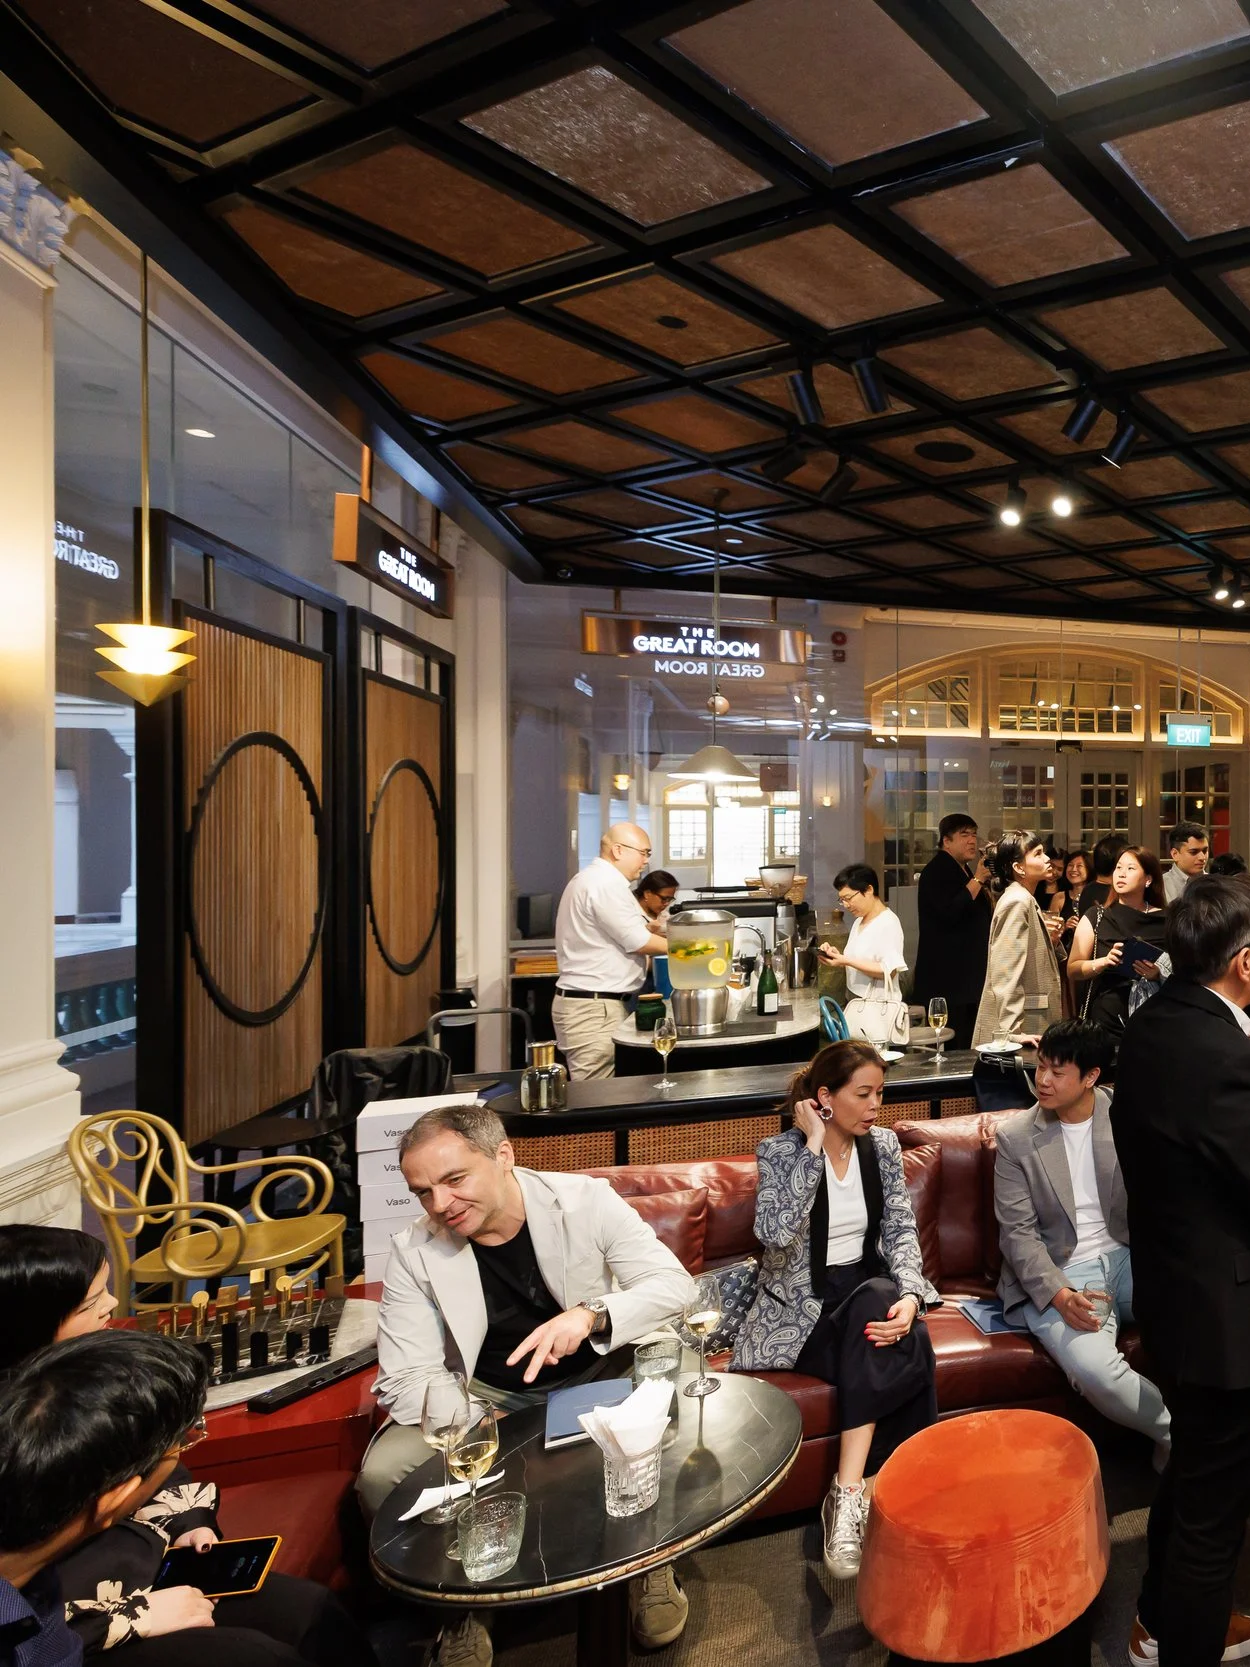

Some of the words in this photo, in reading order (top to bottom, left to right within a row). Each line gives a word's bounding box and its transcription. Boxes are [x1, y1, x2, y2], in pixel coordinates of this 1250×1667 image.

[400, 547, 417, 567] THE
[378, 550, 410, 585] GREAT
[408, 569, 435, 601] ROOM
[680, 626, 714, 638] THE
[633, 635, 697, 654] GREAT
[701, 640, 760, 658] ROOM
[1176, 727, 1201, 743] EXIT
[386, 1198, 410, 1206] Vaso
